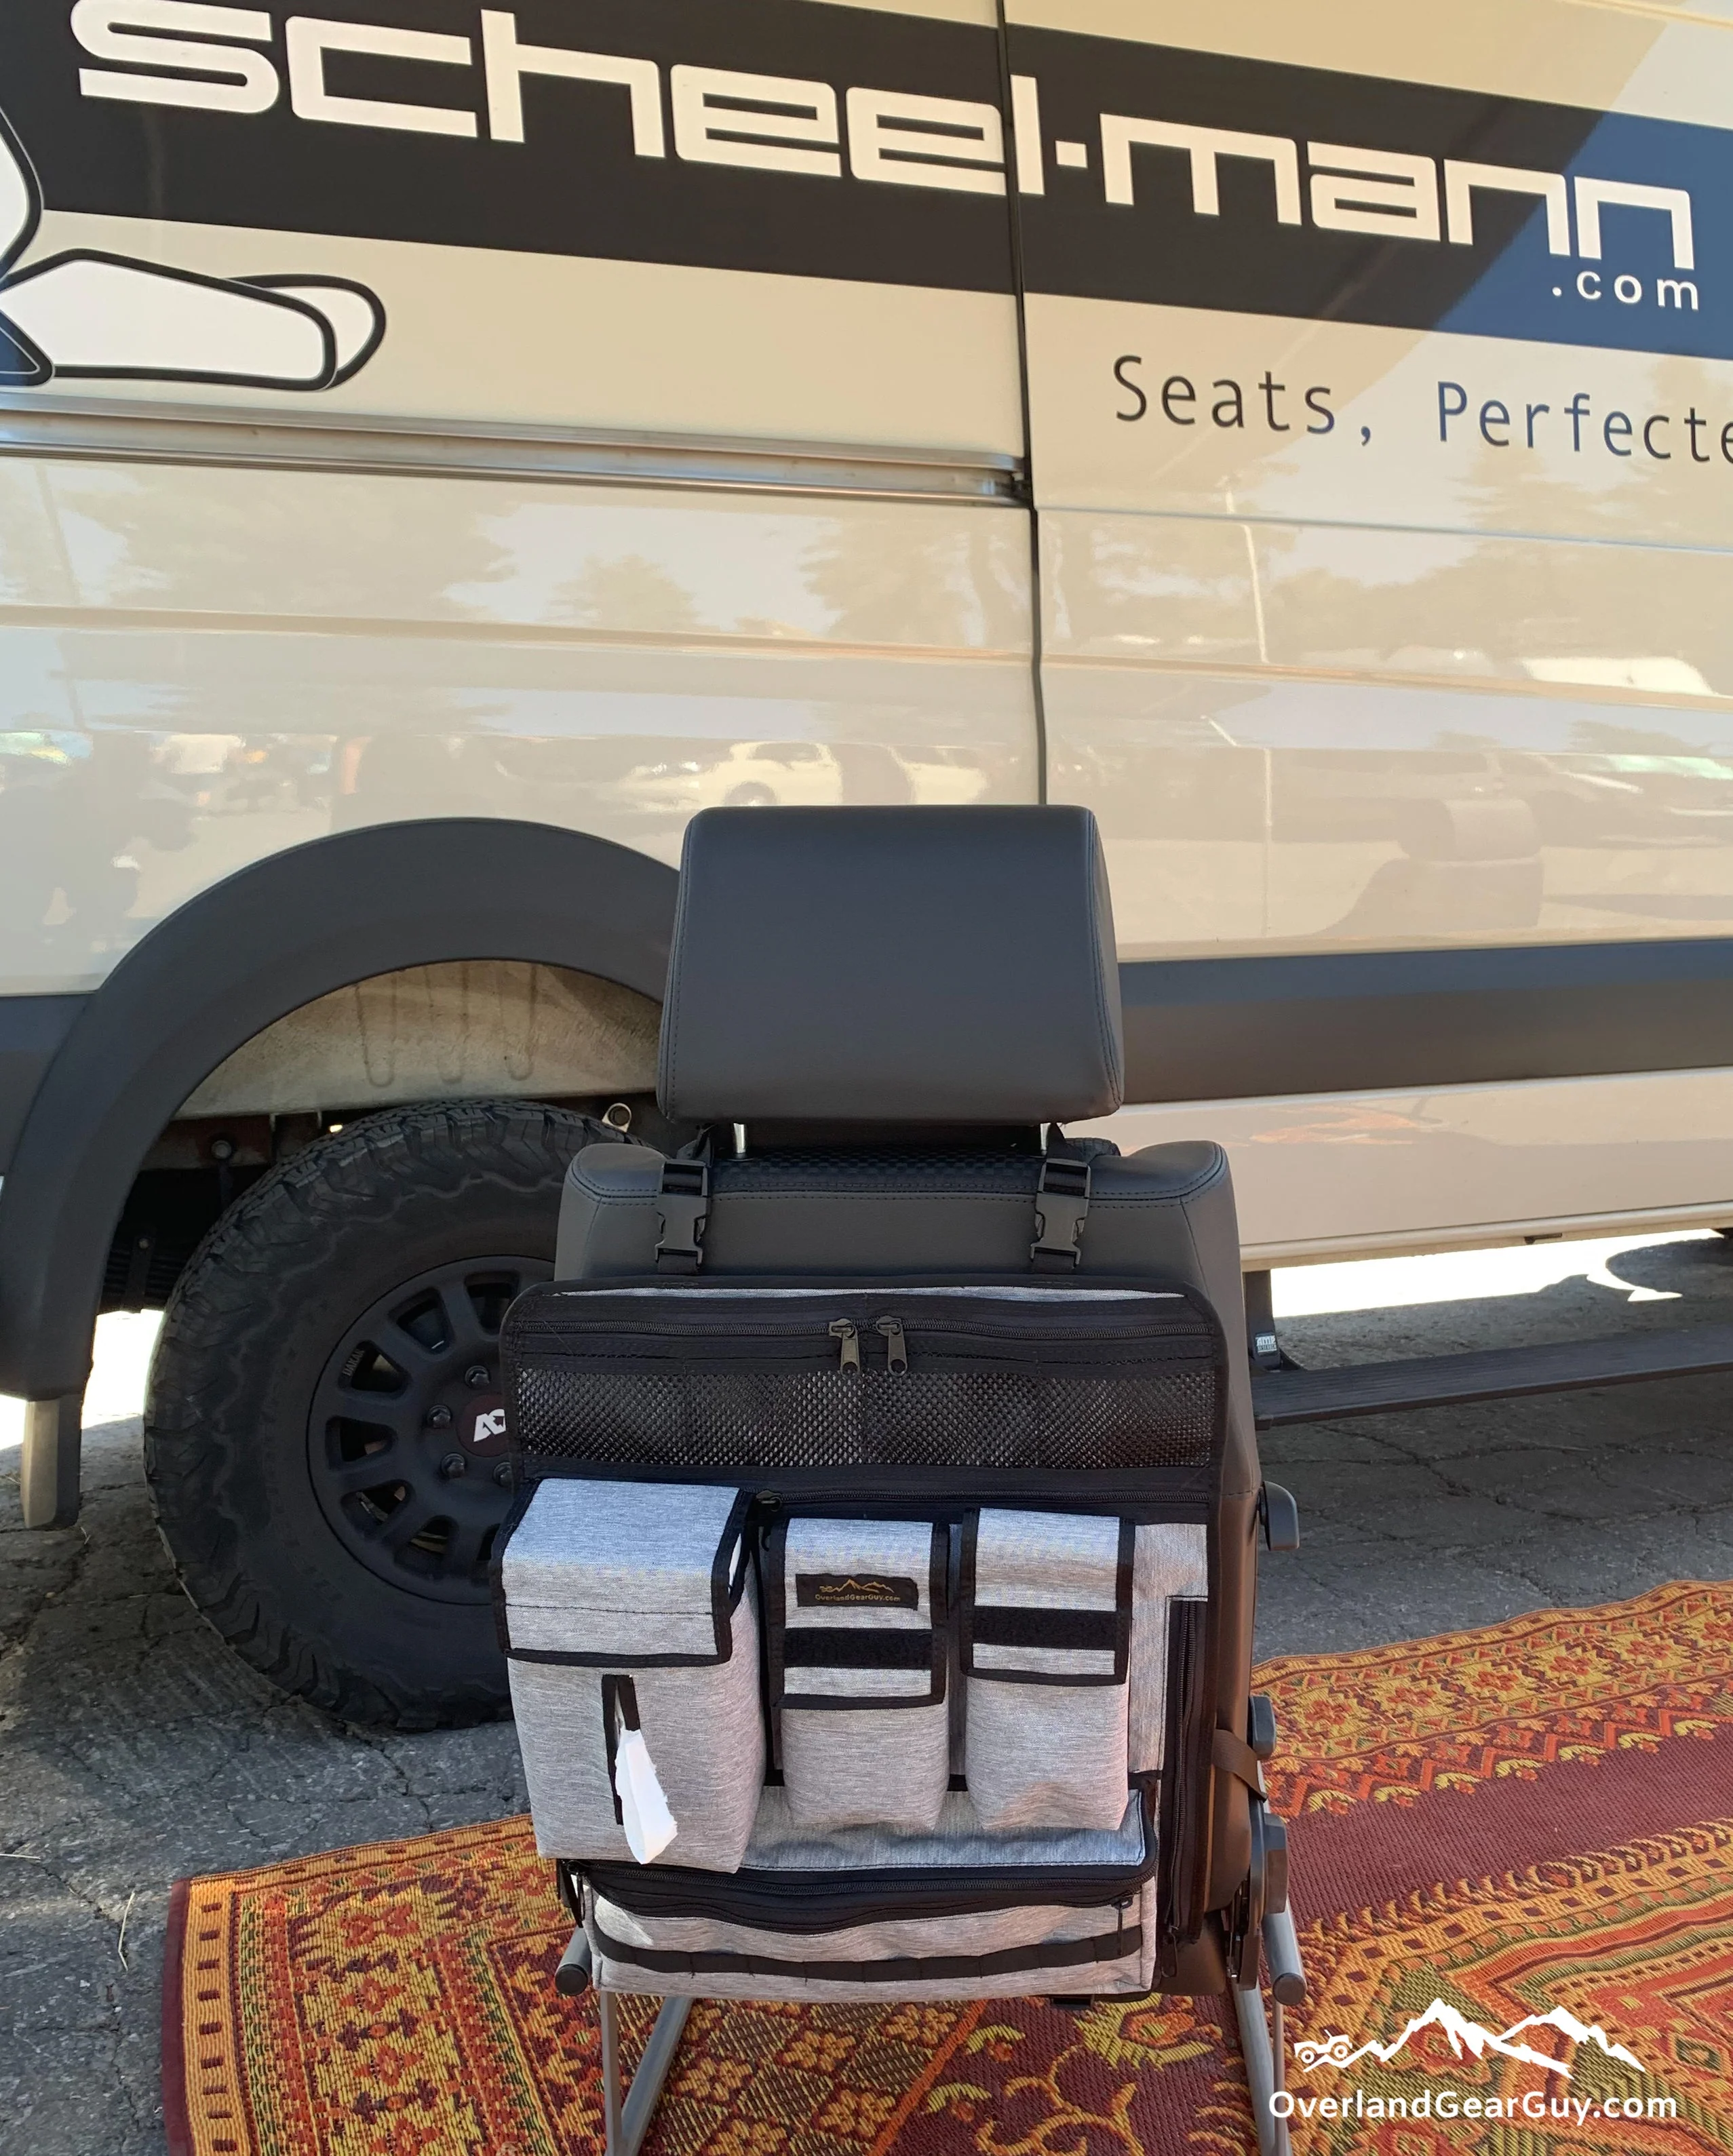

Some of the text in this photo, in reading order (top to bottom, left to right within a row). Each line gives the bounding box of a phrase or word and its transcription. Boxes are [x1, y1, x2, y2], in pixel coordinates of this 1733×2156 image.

[1552, 270, 1698, 311] .com
[1113, 355, 1371, 448] Seats,
[815, 1593, 901, 1603] OverlandGearGuy.com
